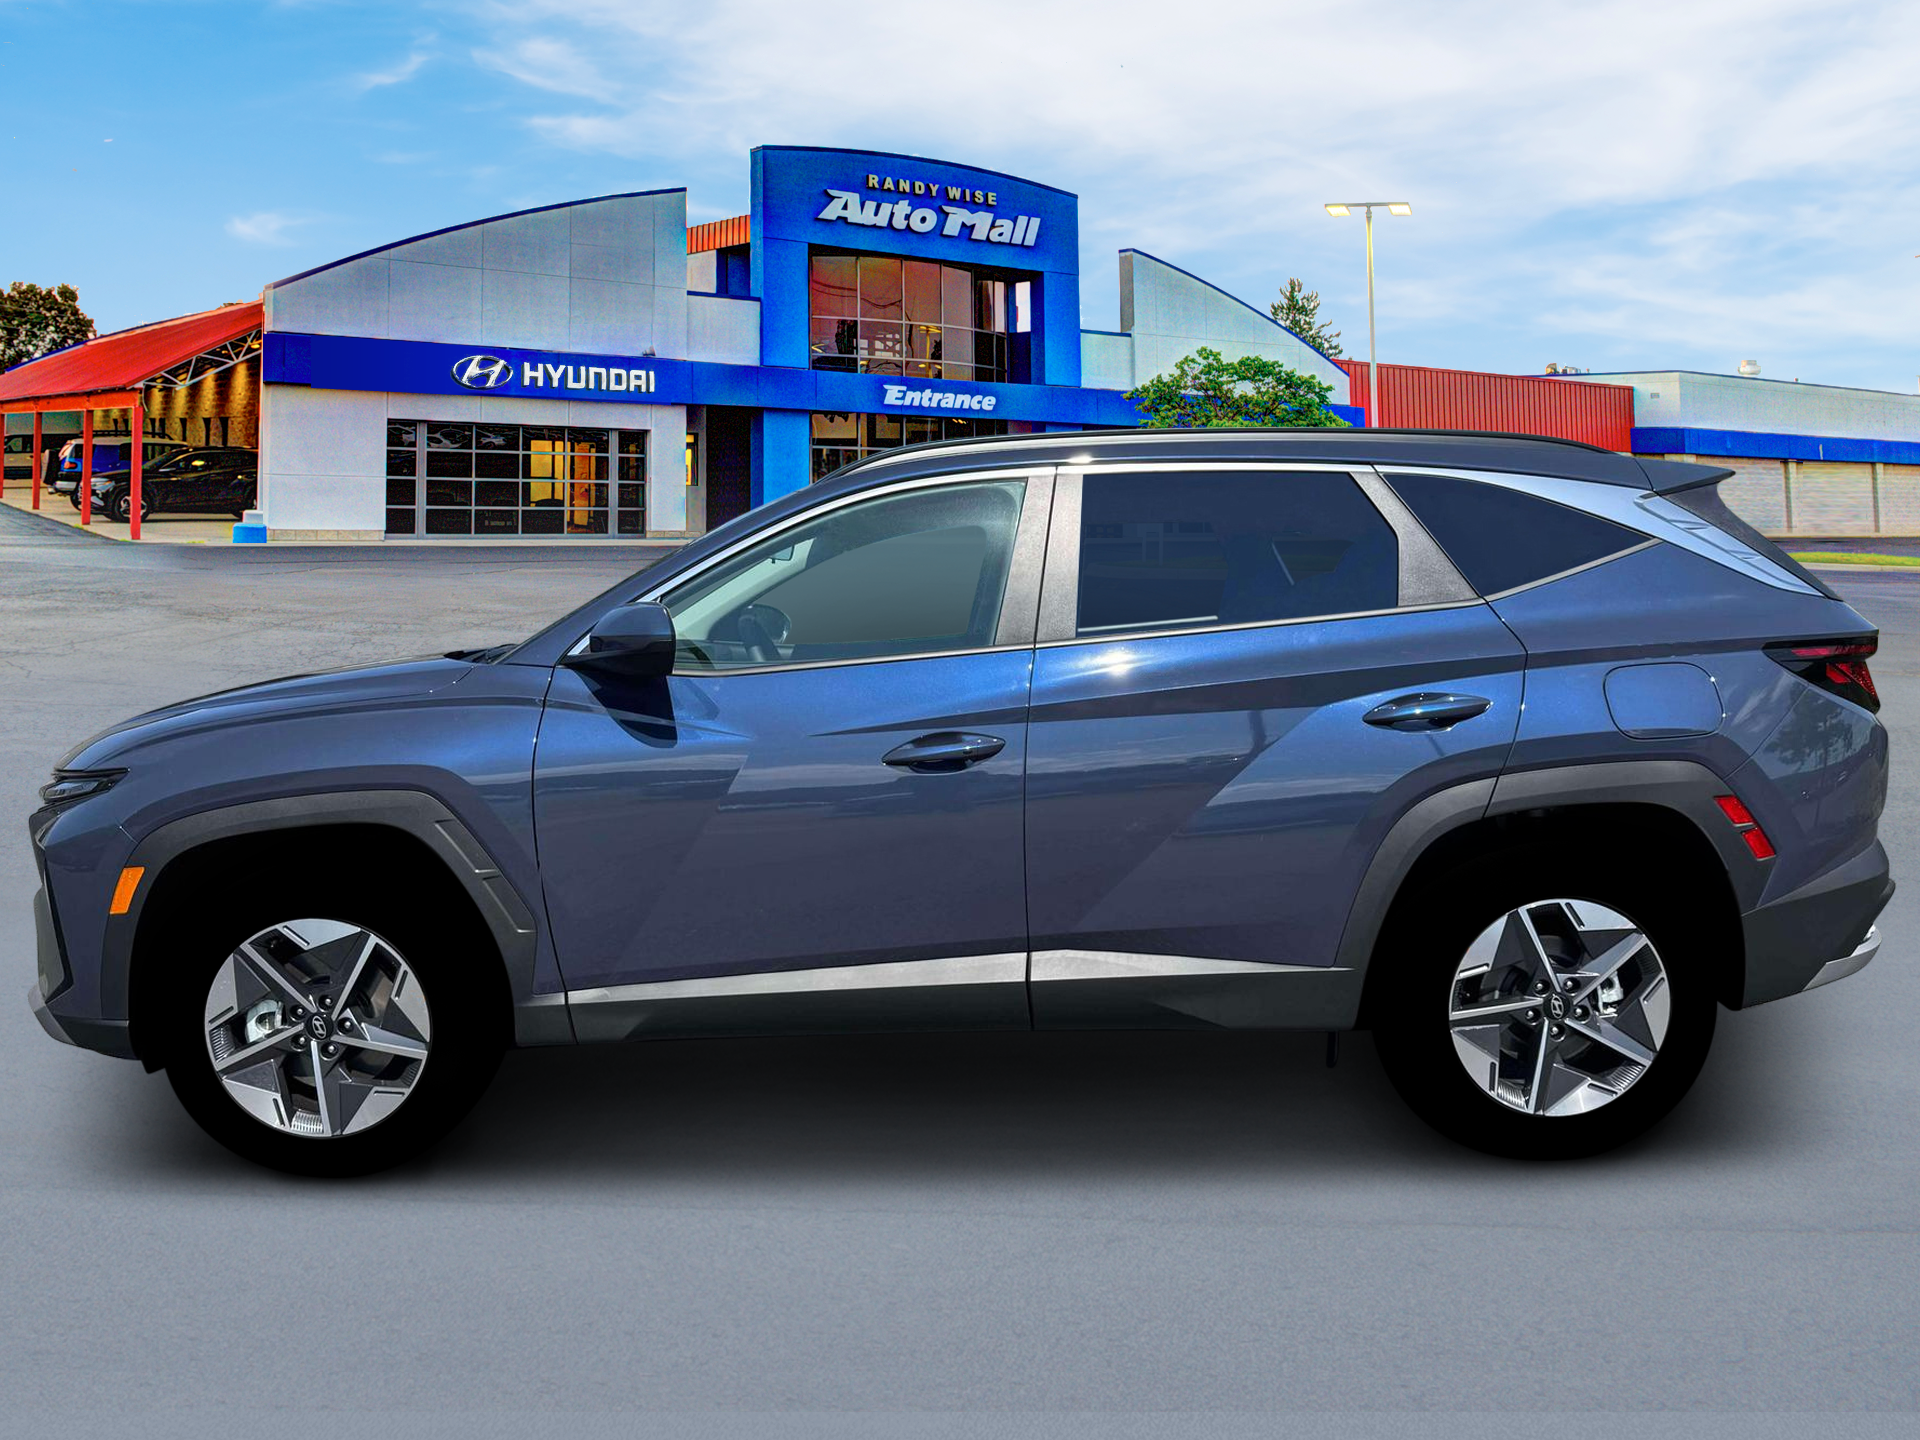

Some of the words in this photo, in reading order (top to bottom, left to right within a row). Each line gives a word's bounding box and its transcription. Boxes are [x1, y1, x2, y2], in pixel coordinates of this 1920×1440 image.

[867, 173, 940, 197] RANDY
[947, 186, 998, 205] WISE
[817, 188, 938, 233] Auto
[942, 205, 1041, 247] Mall
[521, 361, 655, 393] HYUNDAI
[883, 385, 997, 411] Entrance
